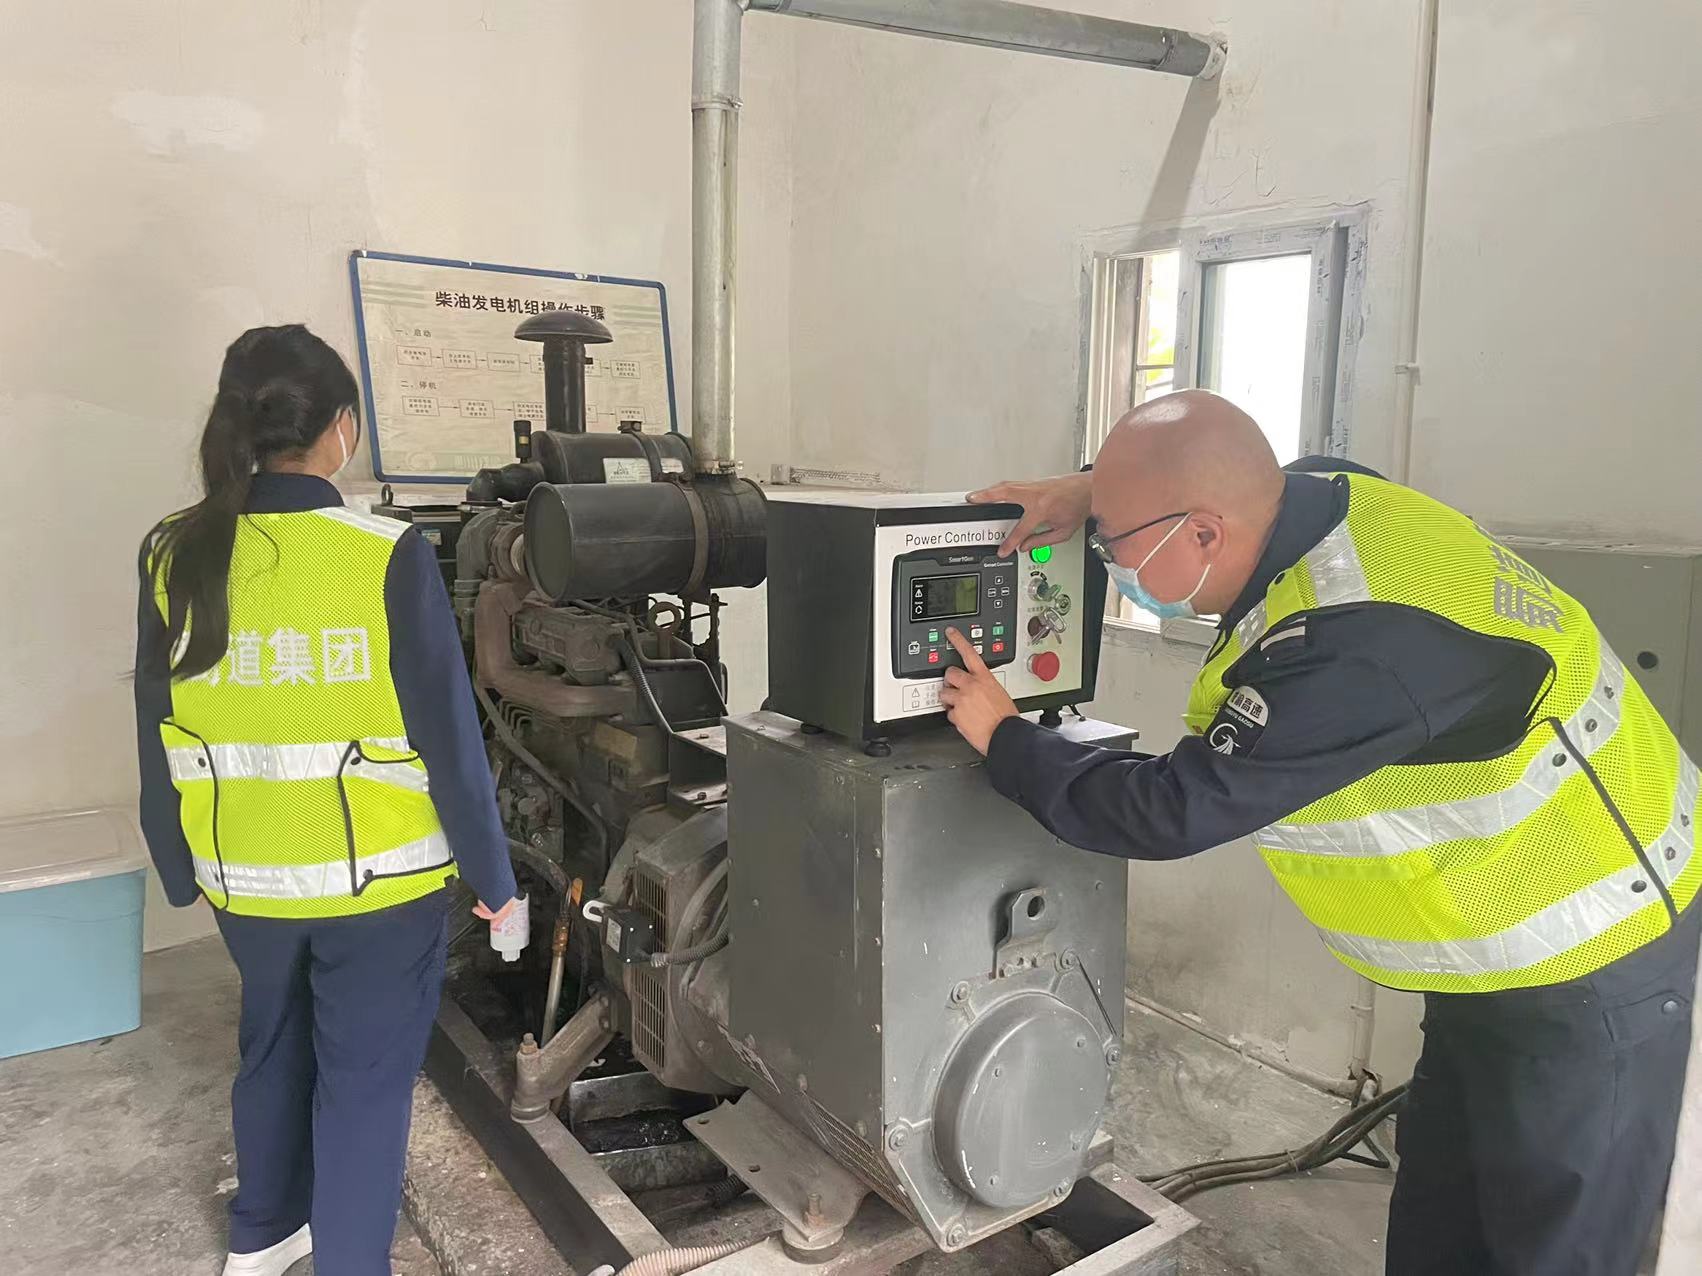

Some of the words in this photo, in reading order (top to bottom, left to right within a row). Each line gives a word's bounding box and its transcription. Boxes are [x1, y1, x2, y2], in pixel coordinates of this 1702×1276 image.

[435, 291, 606, 321] 柴油发电机组操作步骤
[905, 533, 942, 547] Power
[944, 529, 985, 544] Control
[987, 529, 1007, 541] box
[208, 627, 371, 688] 道集团
